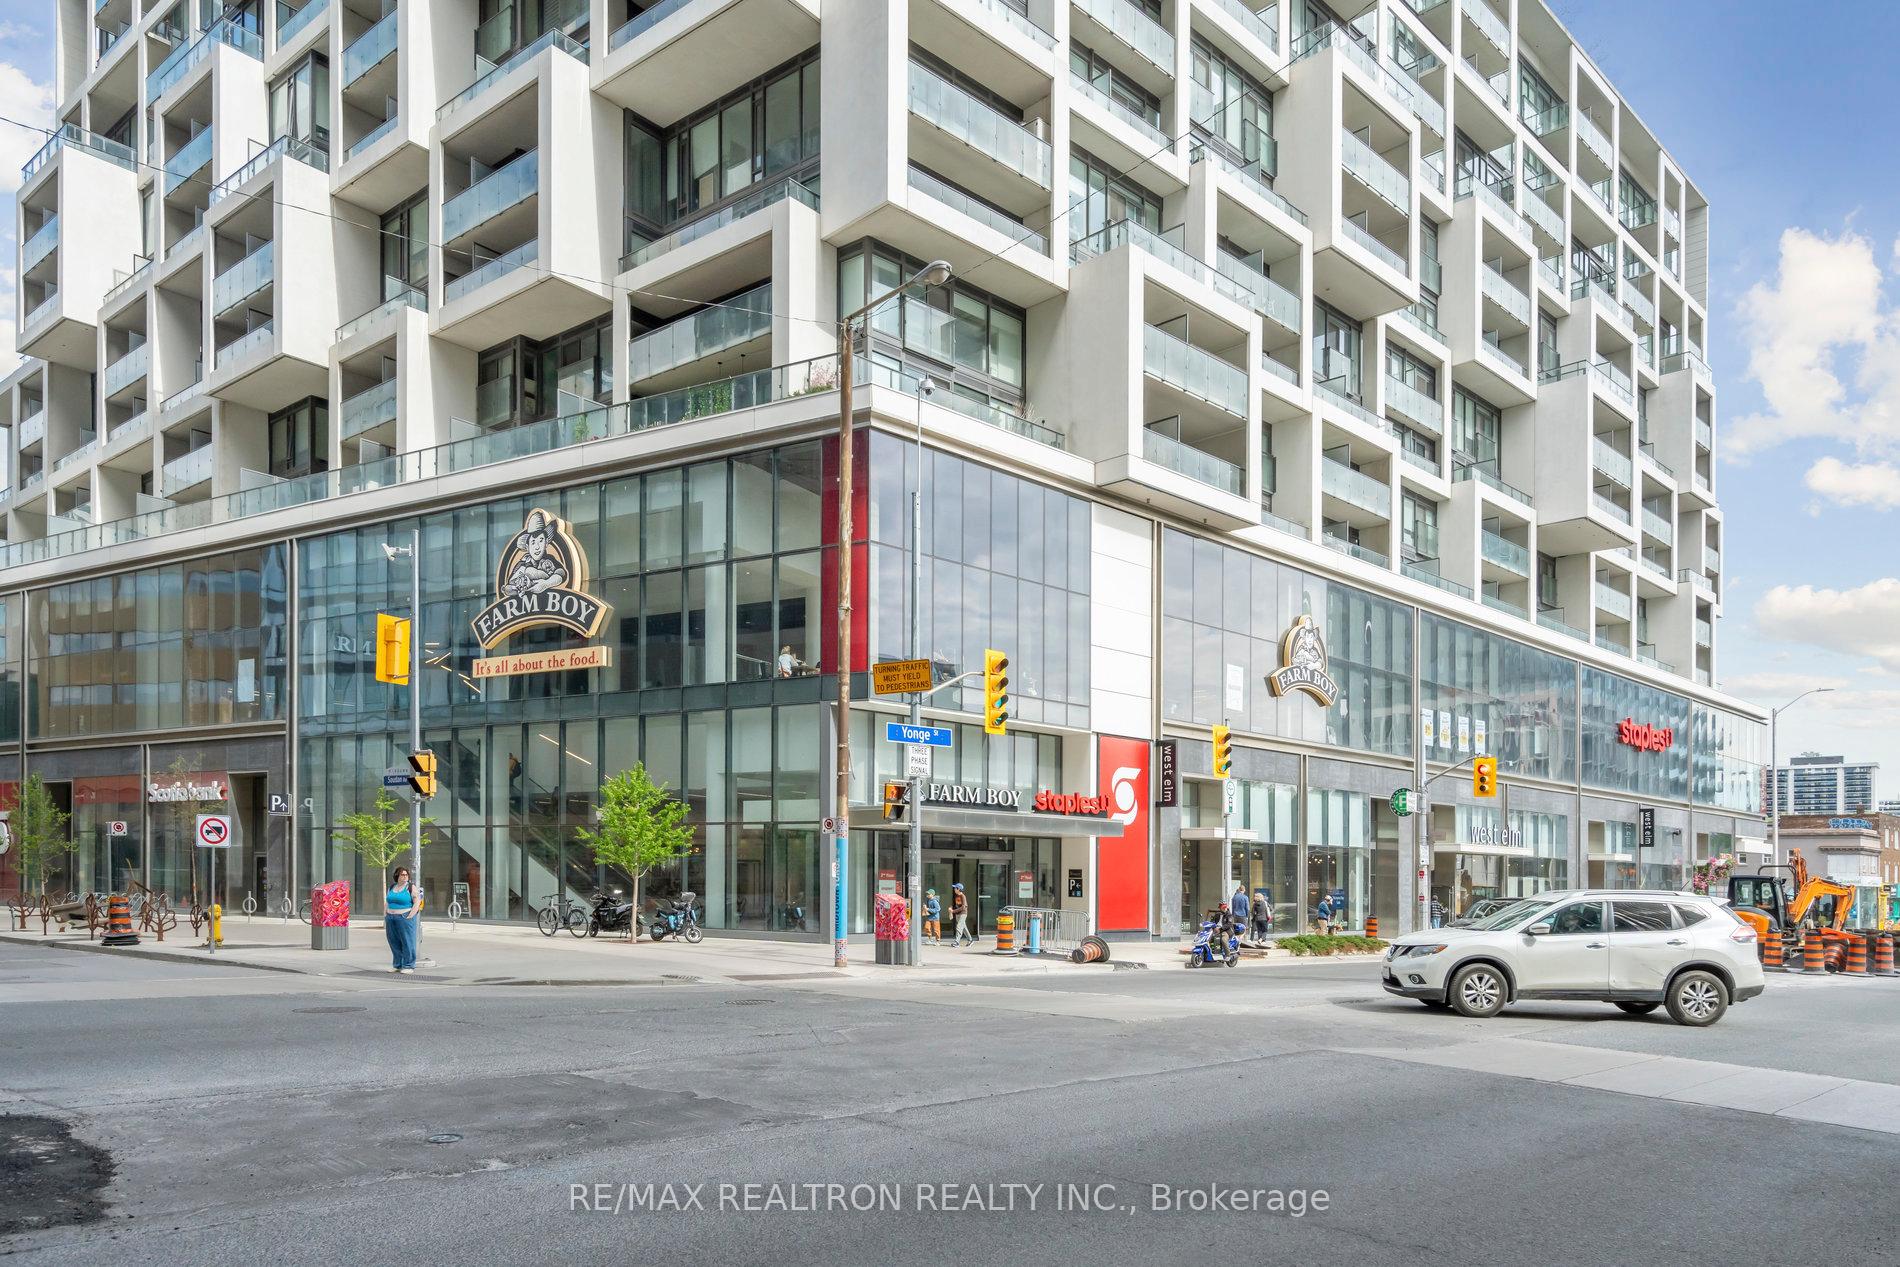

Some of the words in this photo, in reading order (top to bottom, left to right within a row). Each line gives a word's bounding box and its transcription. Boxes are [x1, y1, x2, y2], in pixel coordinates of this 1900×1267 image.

[478, 593, 540, 639] FARM
[545, 591, 595, 623] BOY
[476, 661, 491, 676] It's
[495, 660, 508, 673] all
[512, 658, 543, 672] about
[548, 655, 565, 668] the
[570, 651, 599, 666] food.
[875, 665, 900, 674] TURNING
[902, 661, 929, 671] TRAFFIC
[883, 674, 900, 682] MUST
[902, 672, 920, 680] YIELD
[1279, 667, 1311, 689] FARM
[1313, 671, 1336, 697] BOY
[876, 684, 885, 692] TO
[886, 680, 930, 691] PEDESTRIANS
[901, 726, 930, 743] Yonge
[911, 746, 927, 756] THREE
[911, 756, 928, 765] PHASE
[1164, 745, 1173, 775] west
[910, 766, 928, 775] SIGNAL
[148, 780, 223, 803] Scotiabank
[929, 783, 981, 804] FARM
[986, 788, 1022, 807] BOY
[1164, 780, 1173, 802] elm
[271, 795, 281, 811] P
[1471, 824, 1498, 845] west
[1501, 825, 1521, 847] elm
[1069, 879, 1076, 891] P
